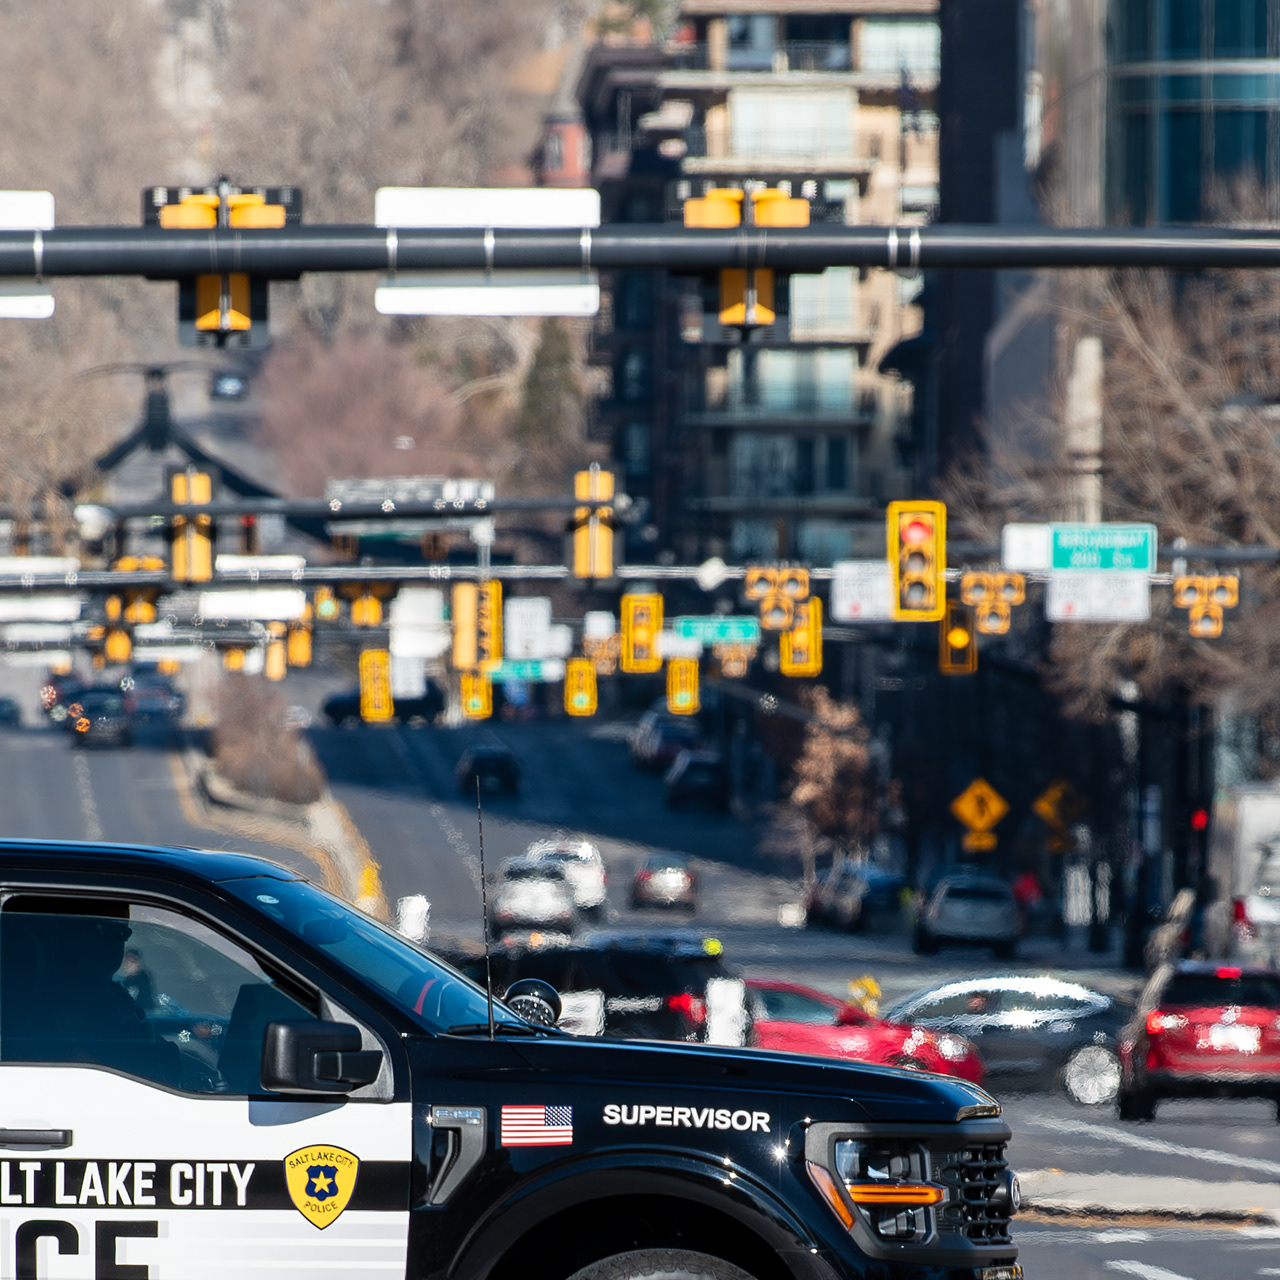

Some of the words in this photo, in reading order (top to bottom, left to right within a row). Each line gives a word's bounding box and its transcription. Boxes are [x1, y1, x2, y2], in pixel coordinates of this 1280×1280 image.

[602, 1103, 771, 1133] SUPERVISOR
[289, 1154, 309, 1169] SALT
[310, 1152, 335, 1162] LAKE
[335, 1153, 355, 1169] CITY
[54, 1160, 156, 1206] LAKE
[168, 1160, 256, 1207] CITY
[304, 1201, 338, 1212] POLICE
